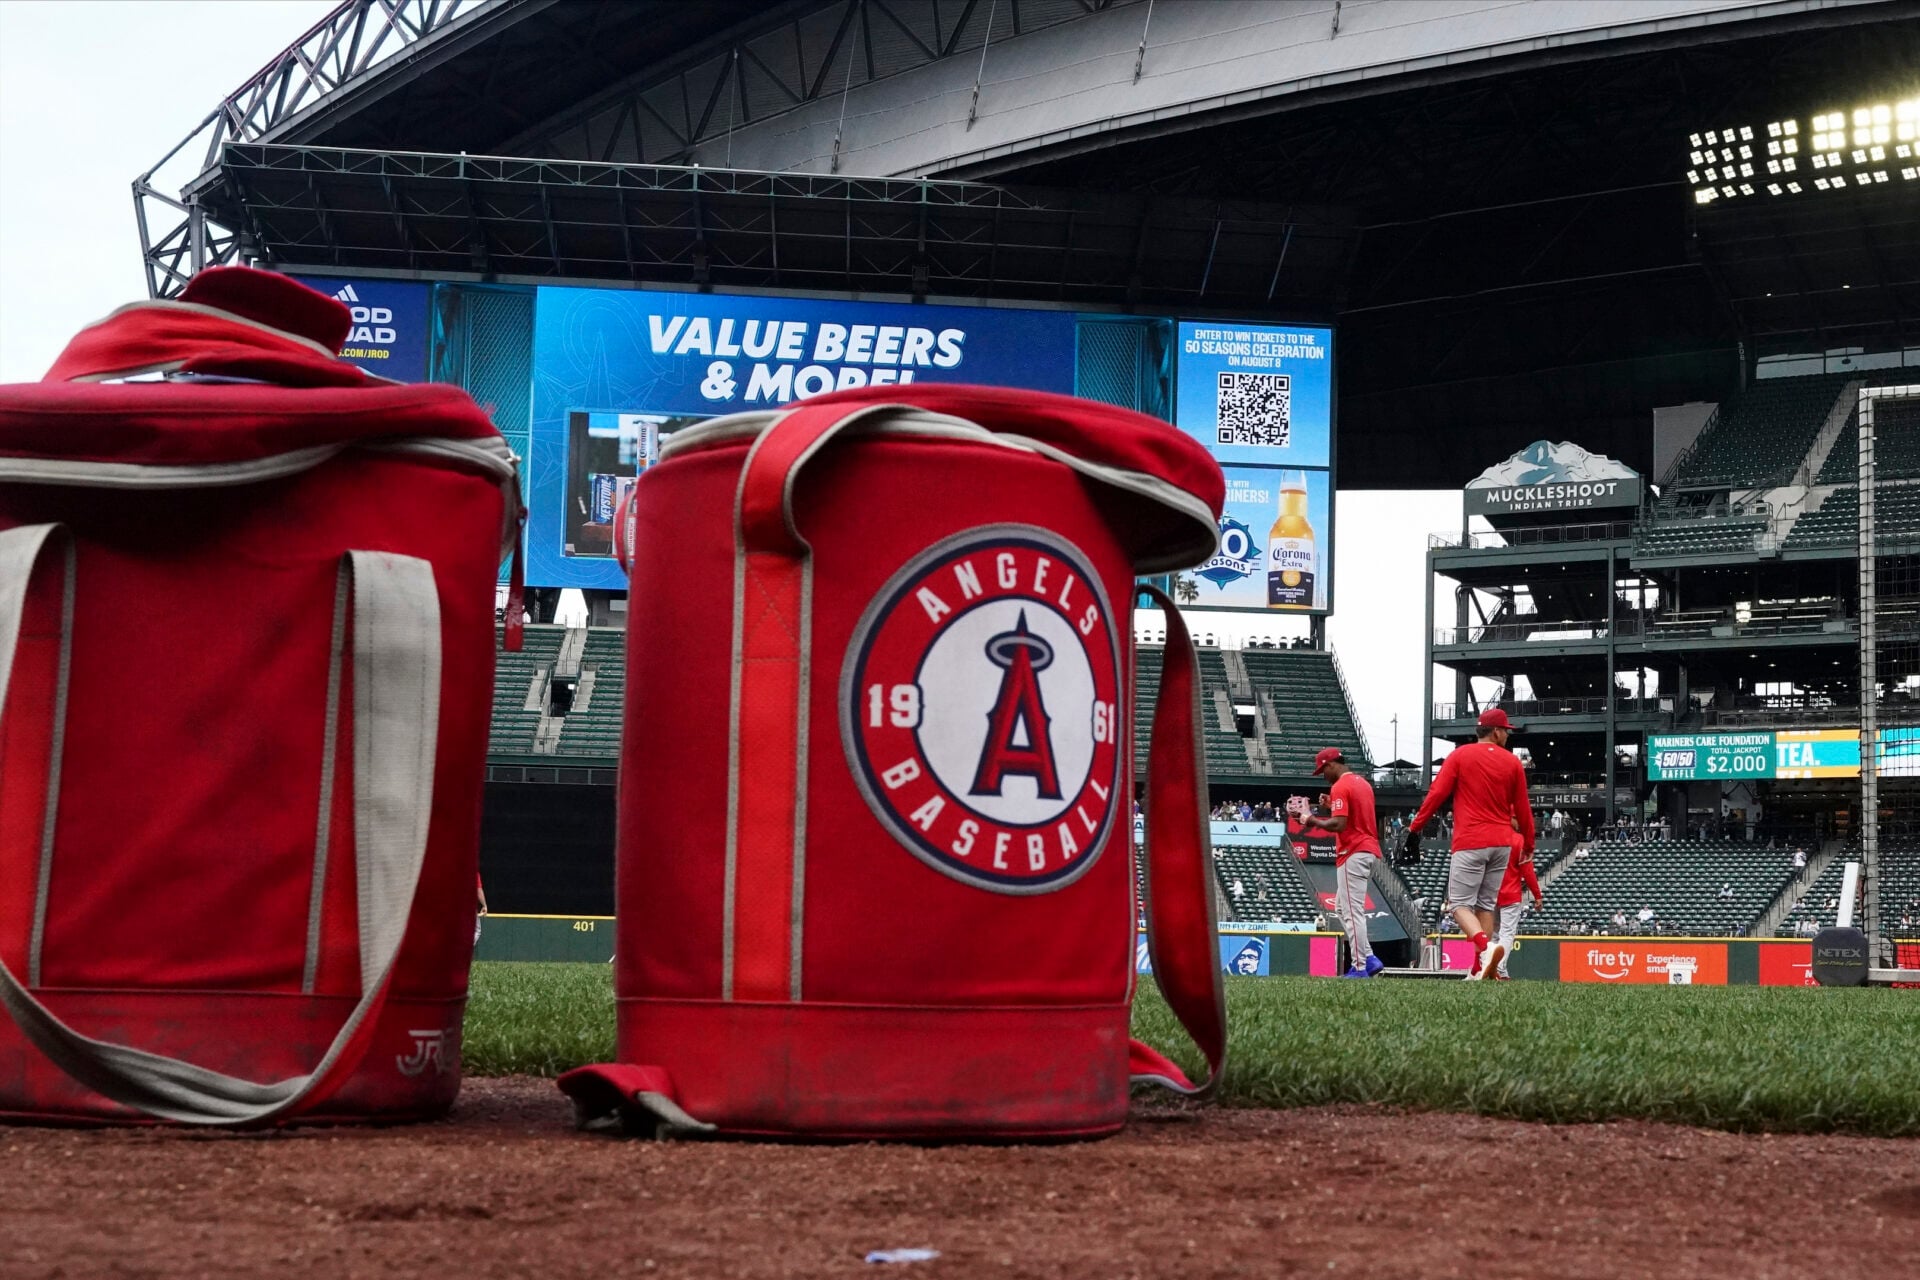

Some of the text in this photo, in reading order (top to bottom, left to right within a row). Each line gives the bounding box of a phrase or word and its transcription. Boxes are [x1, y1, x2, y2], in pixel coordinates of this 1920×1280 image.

[350, 306, 393, 324] OD
[648, 315, 966, 368] VALUE BEERS
[1195, 329, 1315, 345] ENTER TO WIN TICKETS TO THE
[1185, 340, 1325, 360] 50 SEASONS CELEBRATION
[1228, 355, 1281, 368] ON AUGUST 8
[700, 361, 737, 400] &
[600, 478, 613, 519] KEYSTONE
[1225, 489, 1269, 504] RINERS!
[1486, 482, 1618, 504] MUCKLESHOOT
[1510, 498, 1593, 511] INDIAN TRIBE
[1221, 528, 1248, 561] 0
[1272, 548, 1311, 561] Corona
[1282, 560, 1303, 568] Extra
[916, 553, 1099, 635] ANGELS
[868, 684, 922, 728] 19
[1093, 700, 1115, 744] 61
[1654, 735, 1770, 748] MARINERS CARE FOUNDATION
[1733, 746, 1763, 754] JACKPOT
[1776, 742, 1820, 766] TEA.
[1662, 751, 1694, 767] 50/50
[1707, 755, 1766, 774] $2,000
[1662, 769, 1695, 779] RAFFLE
[1555, 794, 1588, 804] HERE
[882, 757, 1110, 871] BASEBALL
[573, 921, 595, 932] 401
[1587, 950, 1635, 967] fire tv
[1646, 954, 1697, 964] Experience
[1817, 948, 1862, 958] NETEX
